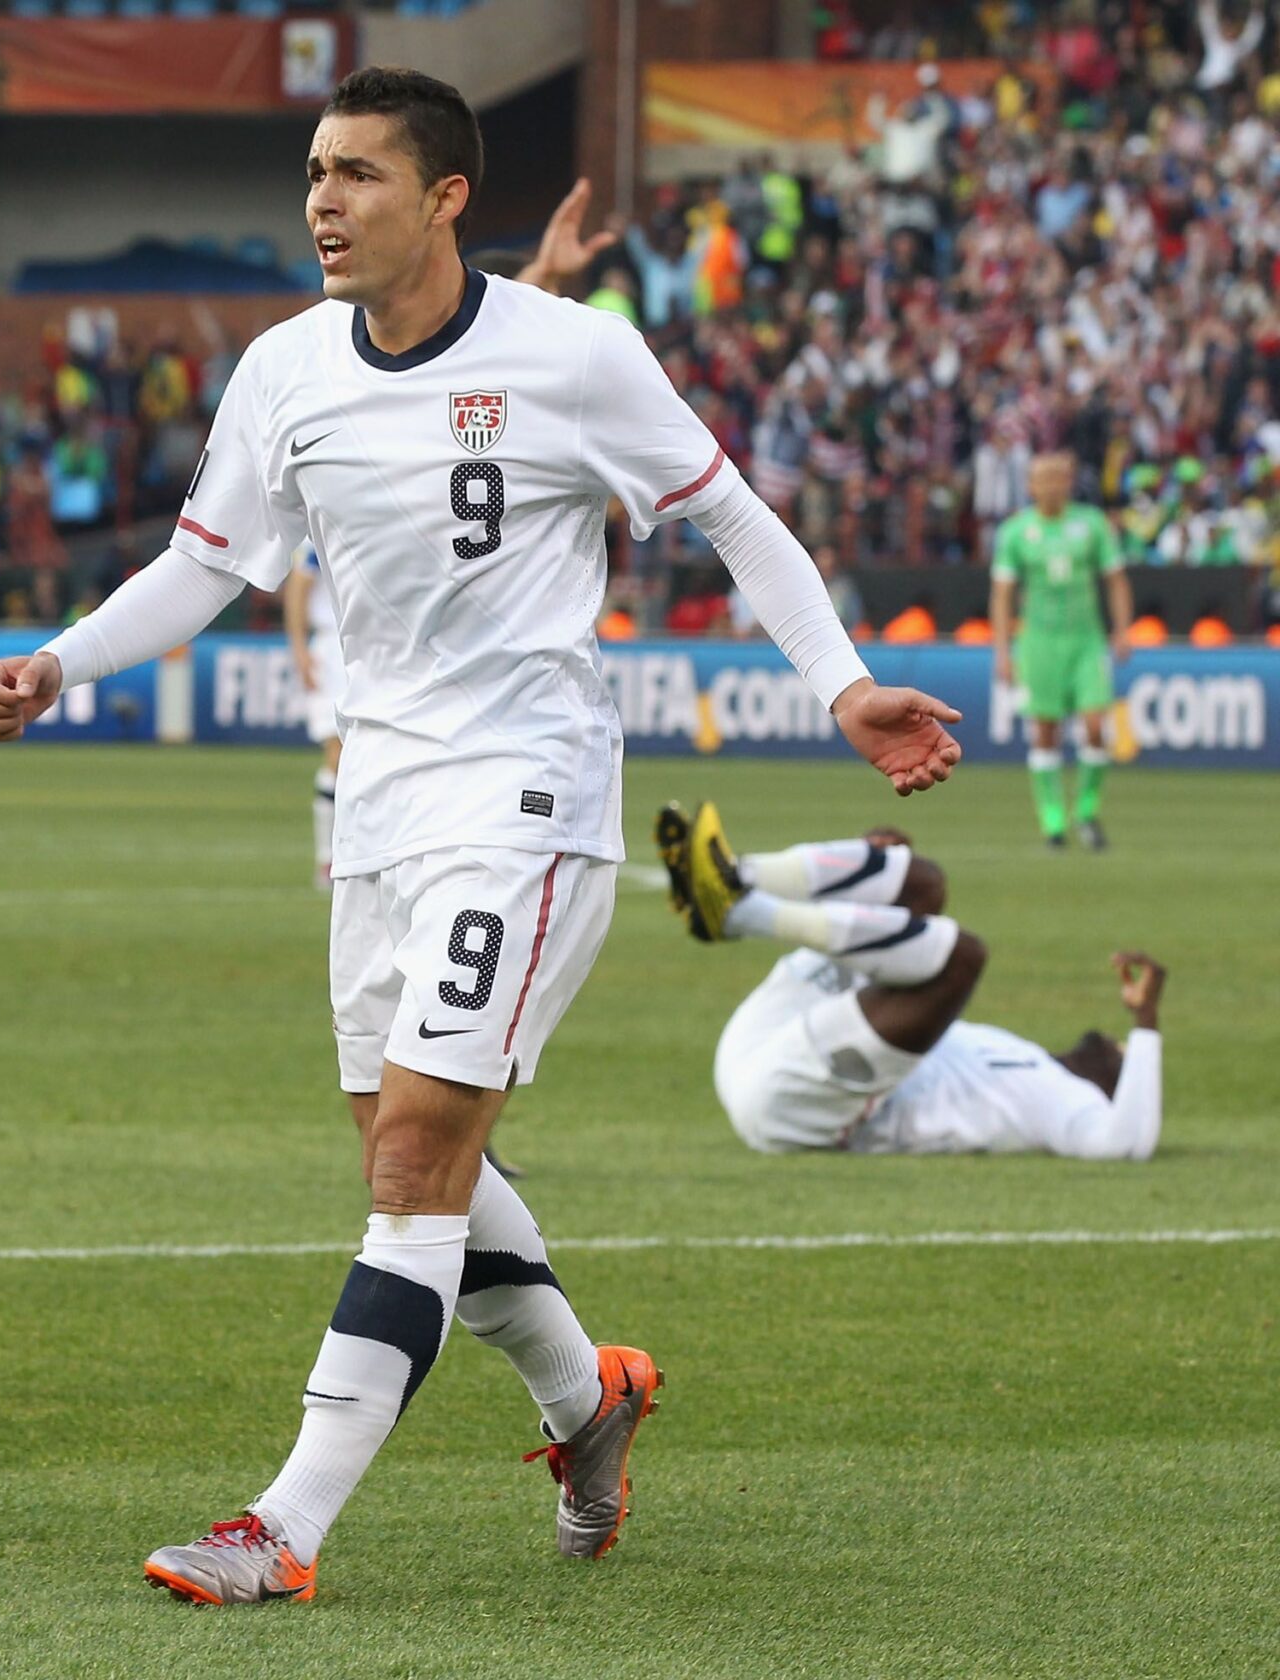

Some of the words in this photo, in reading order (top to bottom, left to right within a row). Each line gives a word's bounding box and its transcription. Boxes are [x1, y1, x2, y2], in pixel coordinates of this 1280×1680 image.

[457, 408, 500, 430] US
[451, 462, 505, 560] 9
[438, 909, 504, 1011] 9
